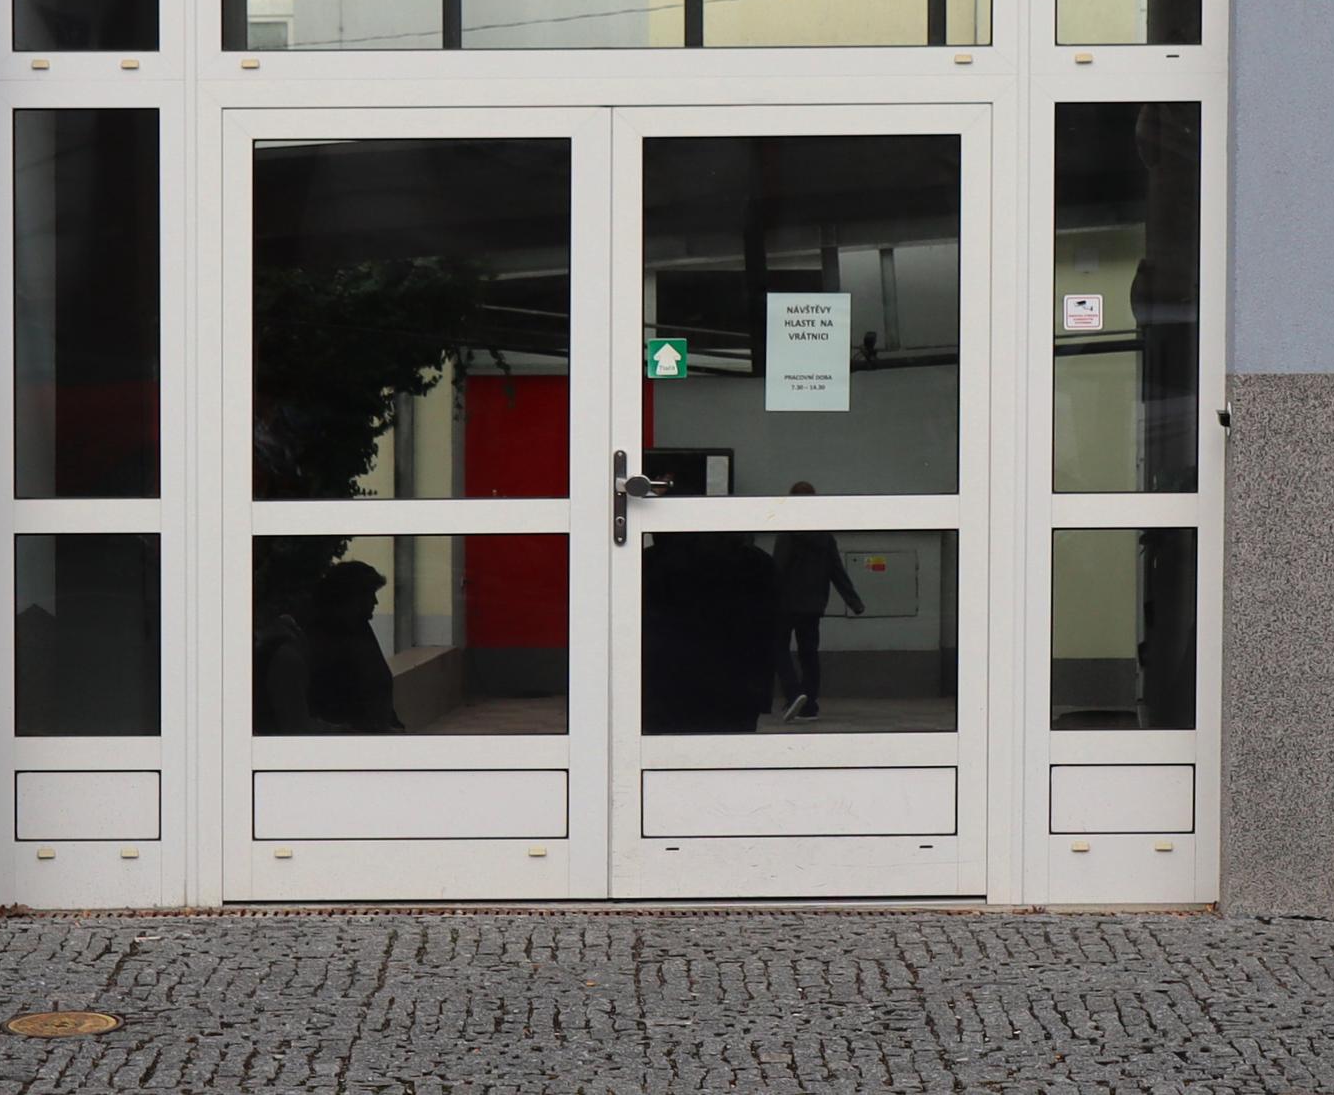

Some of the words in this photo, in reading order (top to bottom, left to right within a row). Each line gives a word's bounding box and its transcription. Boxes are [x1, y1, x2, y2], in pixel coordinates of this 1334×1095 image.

[786, 304, 832, 314] NÁVŠTĚVY
[784, 319, 816, 328] HLASTE
[820, 319, 834, 328] NA
[788, 331, 829, 341] VRÁTNICI
